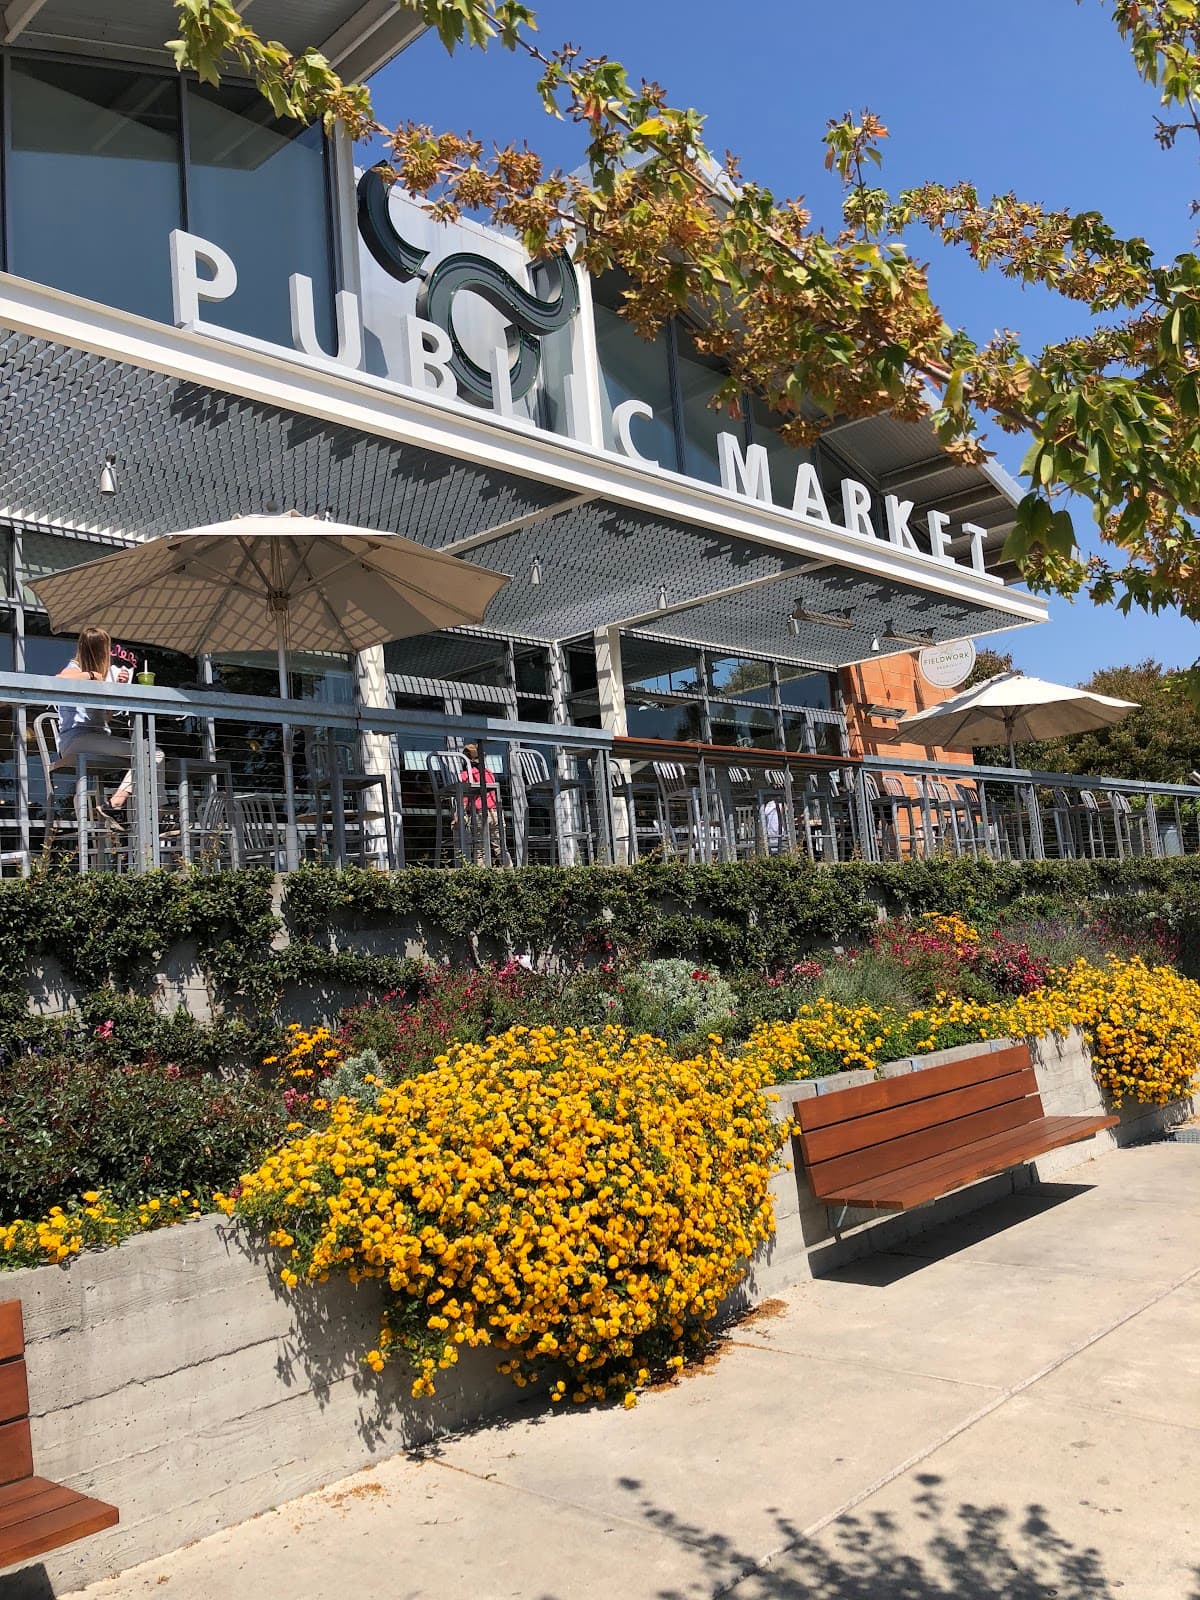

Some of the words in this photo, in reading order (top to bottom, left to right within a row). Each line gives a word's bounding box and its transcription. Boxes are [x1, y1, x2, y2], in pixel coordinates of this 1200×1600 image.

[168, 228, 660, 470] PUBLIC
[716, 430, 989, 575] MARKET
[923, 651, 970, 665] FIELDWORK
